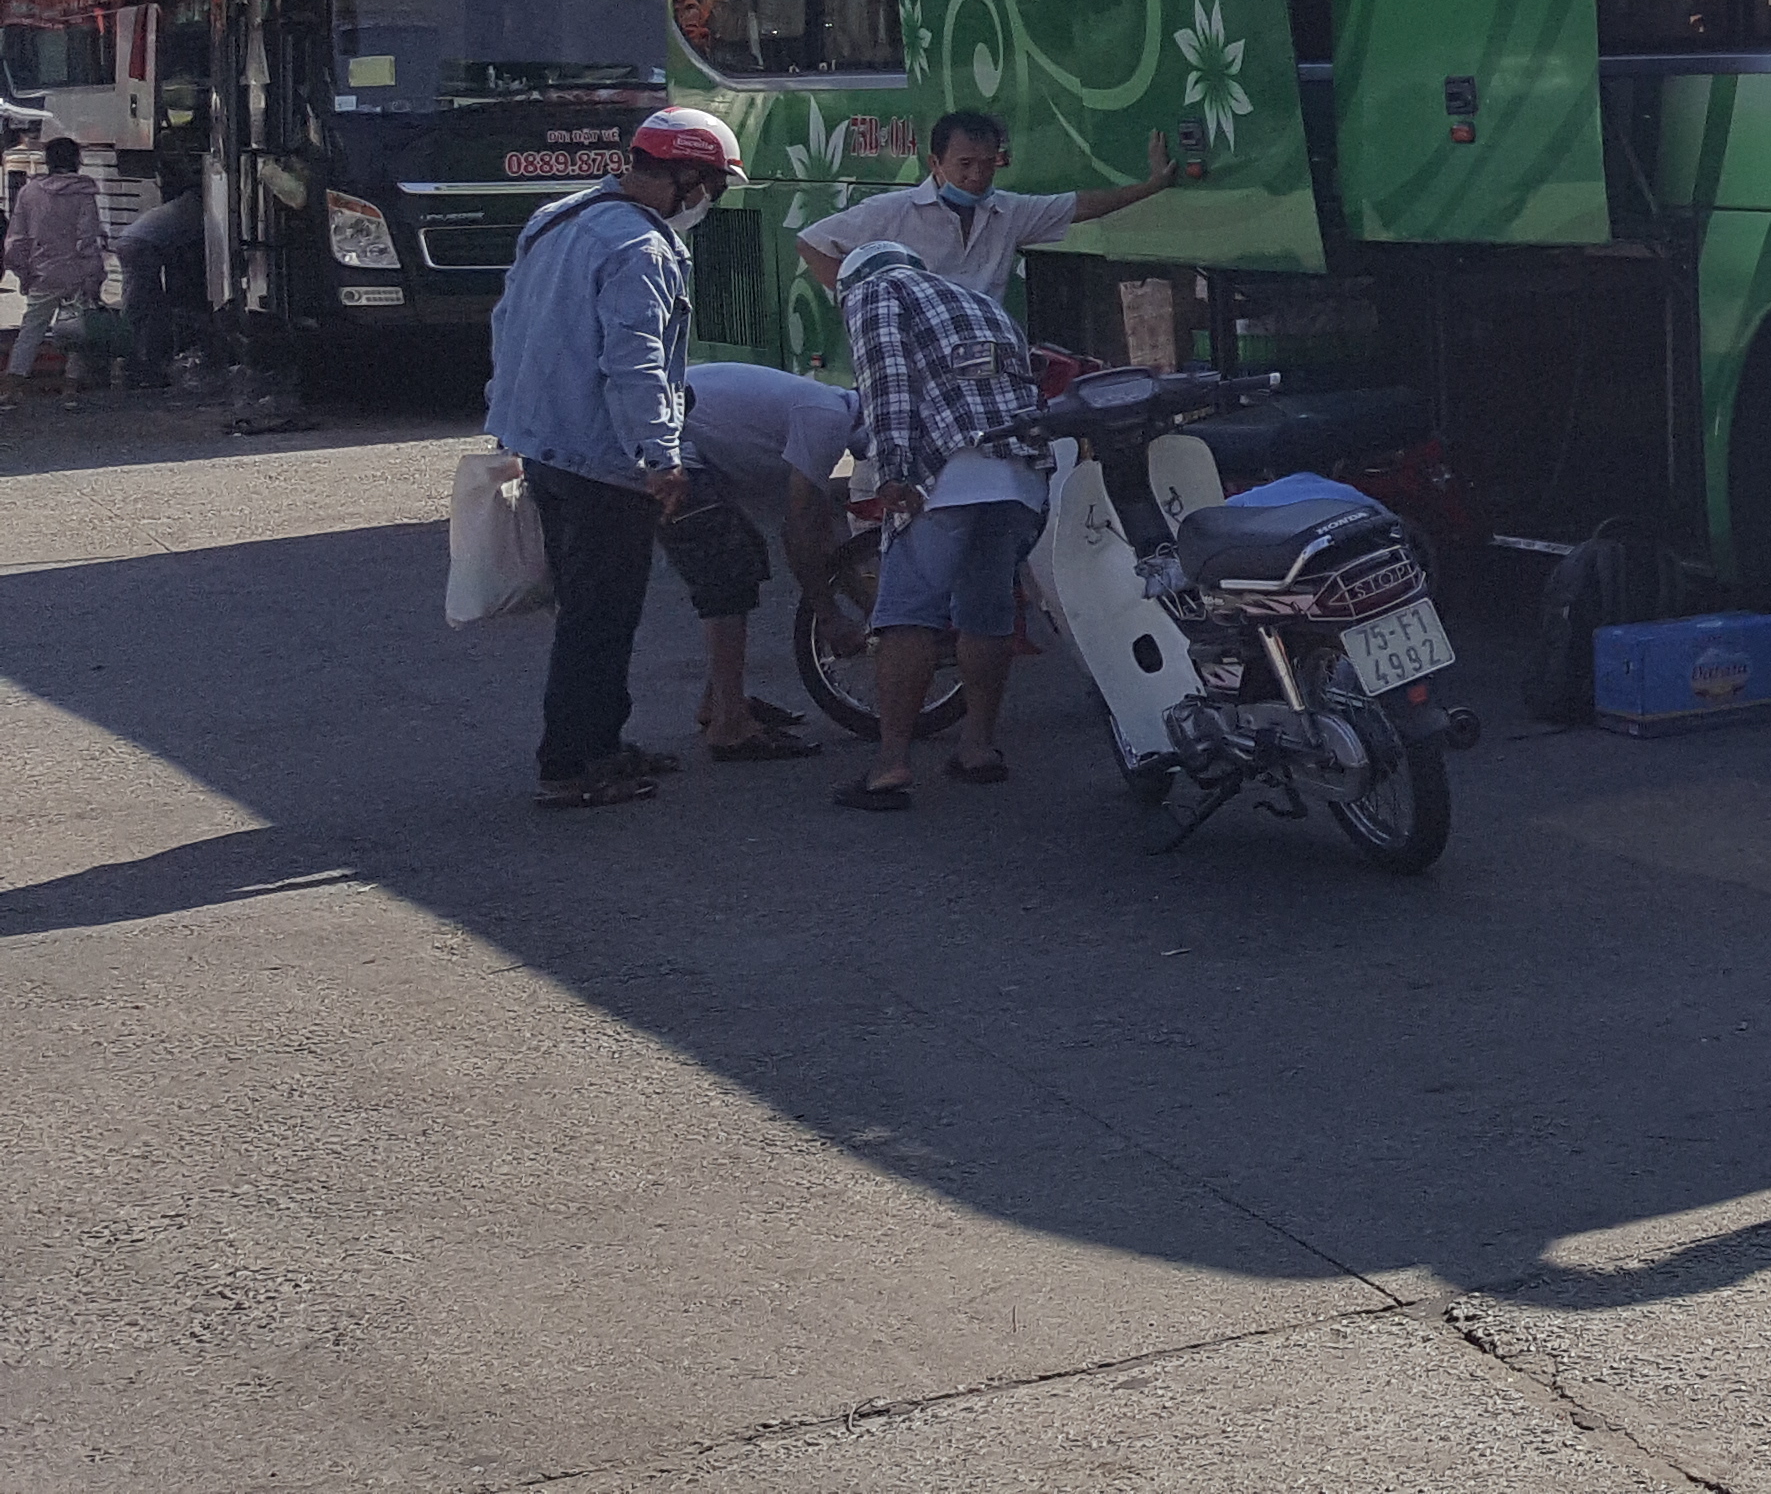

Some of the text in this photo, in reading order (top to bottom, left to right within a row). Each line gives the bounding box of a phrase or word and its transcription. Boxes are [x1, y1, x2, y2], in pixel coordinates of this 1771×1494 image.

[505, 150, 633, 176] 0889.879.
[1316, 512, 1369, 535] HONDA
[1356, 608, 1429, 657] 75-F1
